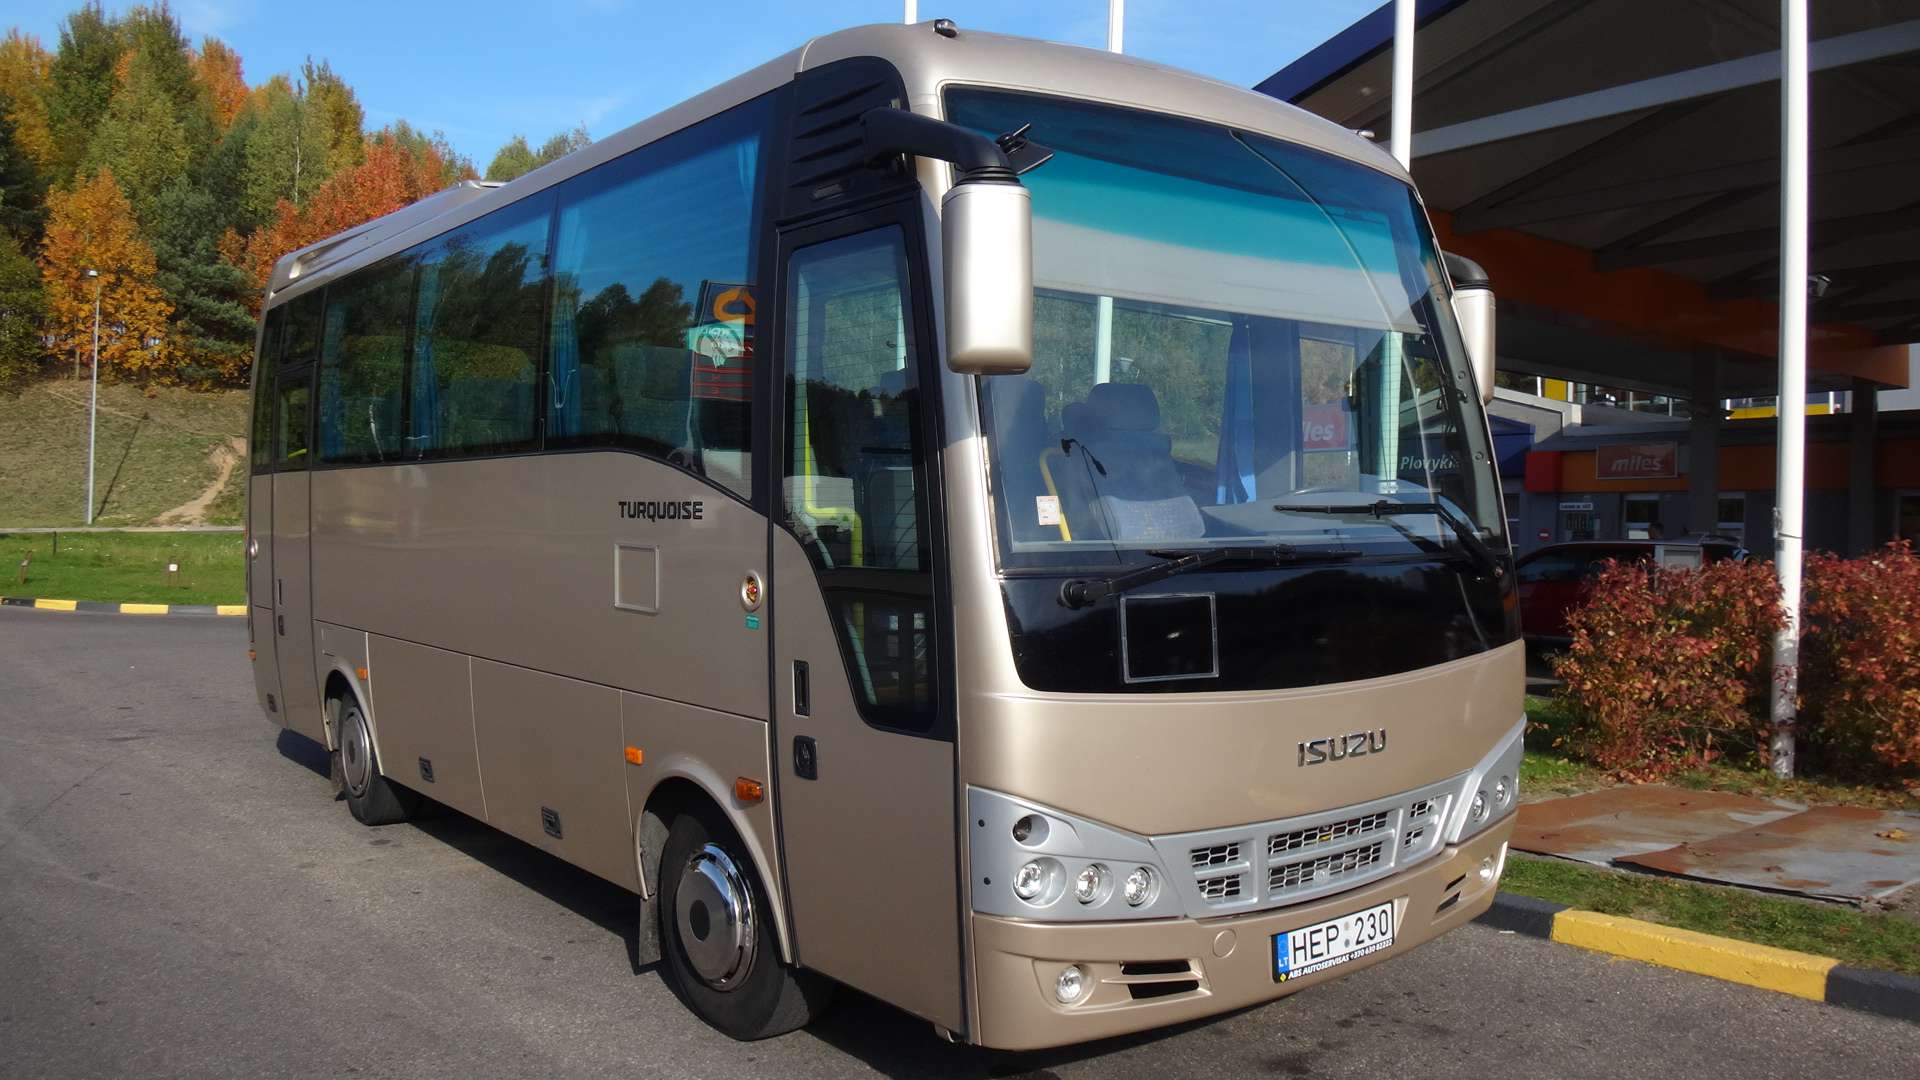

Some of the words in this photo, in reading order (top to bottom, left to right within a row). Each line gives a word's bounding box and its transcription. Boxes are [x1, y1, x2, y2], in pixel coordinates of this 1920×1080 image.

[1608, 455, 1662, 473] miles
[618, 501, 703, 522] TURQUOISE
[1298, 728, 1386, 767] ISUZU
[1292, 924, 1339, 964] HEP
[1354, 909, 1389, 946] 230
[1278, 957, 1289, 967] LT
[1288, 967, 1302, 980] ABS
[1302, 954, 1350, 975] AUTOSERVISAS
